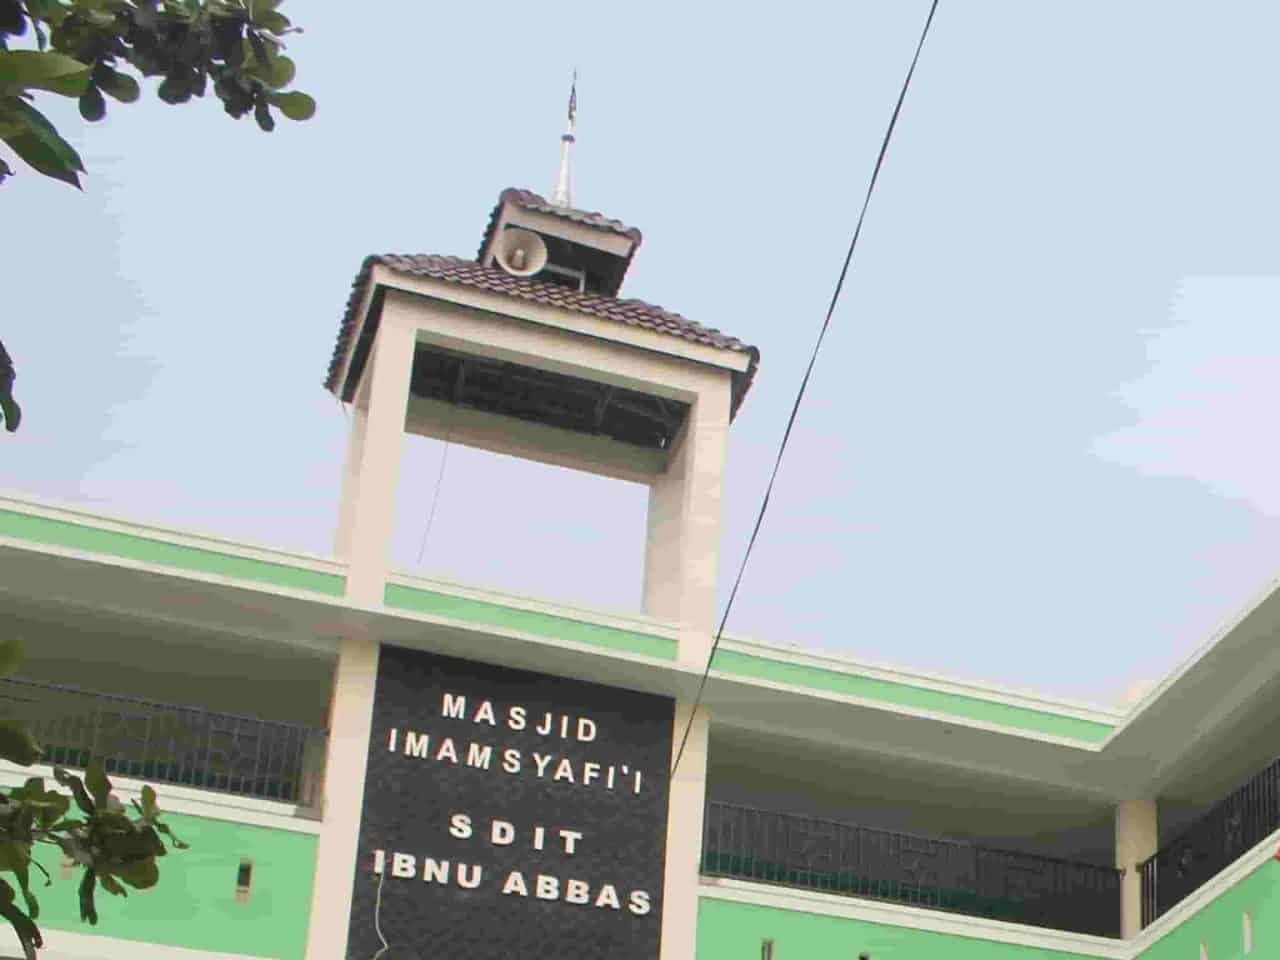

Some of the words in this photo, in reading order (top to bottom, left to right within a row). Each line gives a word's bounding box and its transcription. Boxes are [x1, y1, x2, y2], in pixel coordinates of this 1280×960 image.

[442, 693, 597, 742] MASJID
[449, 813, 582, 855] SDIT
[373, 850, 482, 889] IBNU
[502, 871, 652, 915] ABBAS
